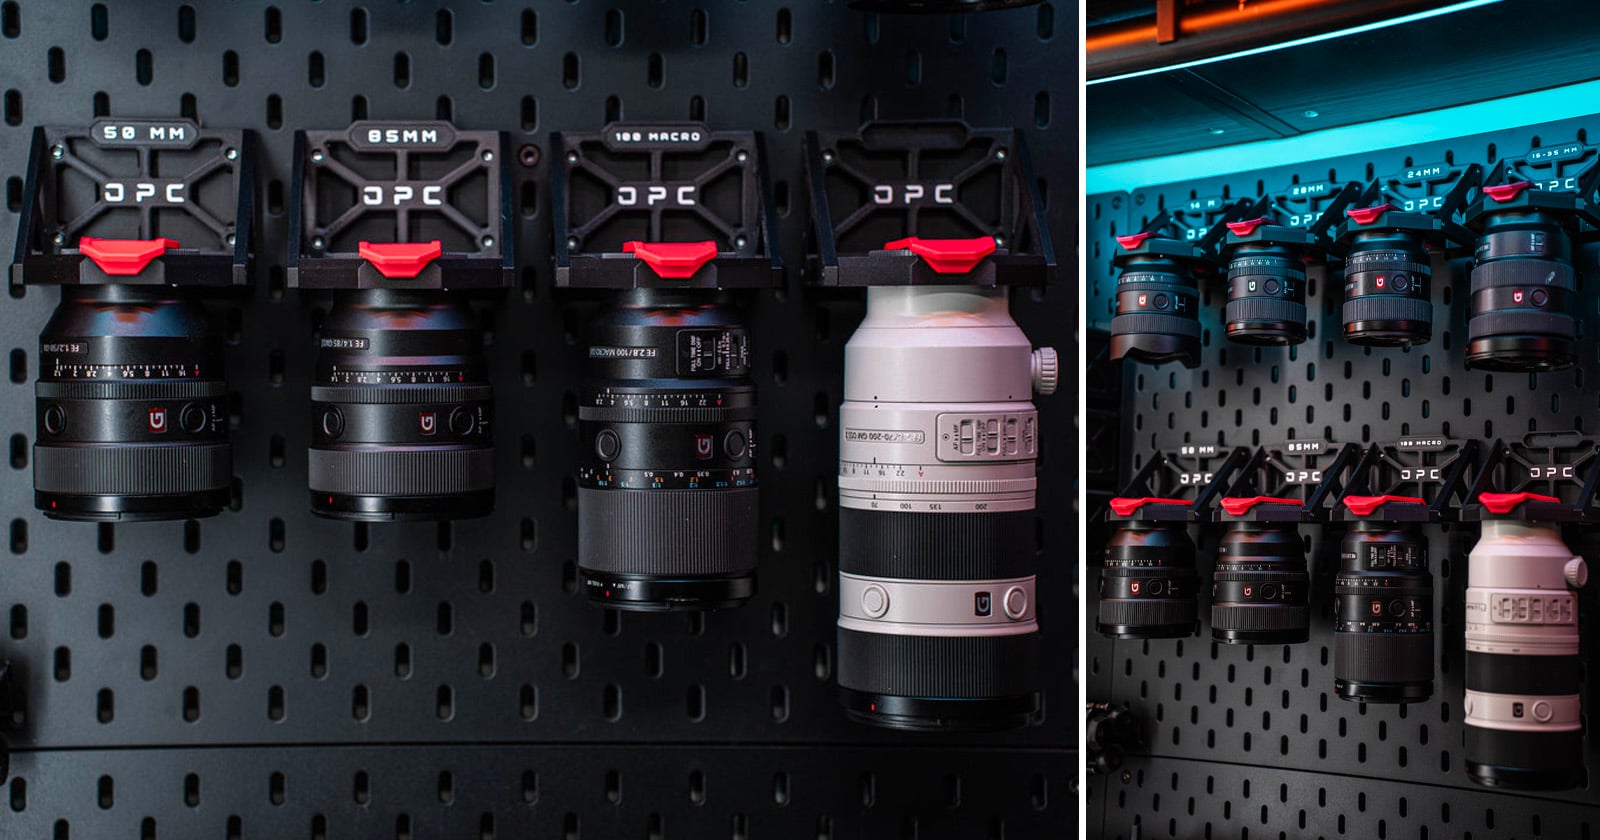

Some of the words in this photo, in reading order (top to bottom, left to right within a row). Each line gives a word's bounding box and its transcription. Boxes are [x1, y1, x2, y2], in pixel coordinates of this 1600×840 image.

[103, 126, 135, 140] 50
[150, 126, 185, 140] MM
[368, 129, 437, 143] 85MM
[615, 132, 641, 142] 100
[648, 132, 700, 142] MACRO
[1532, 149, 1559, 159] 16-35
[1407, 167, 1440, 179] 24MM
[104, 182, 185, 203] JPC
[363, 185, 442, 206] JPC
[618, 186, 695, 205] JPC
[874, 184, 953, 204] JPC
[1292, 184, 1324, 196] 28MM
[1404, 196, 1442, 212] JPC
[1186, 227, 1208, 240] JP
[355, 339, 364, 347] FE
[1181, 446, 1194, 454] 50
[1288, 443, 1319, 451] 85MM
[1286, 472, 1320, 482] JPC
[1401, 470, 1439, 480] JPC
[1530, 466, 1573, 478] JPC
[1180, 474, 1213, 484] JPC
